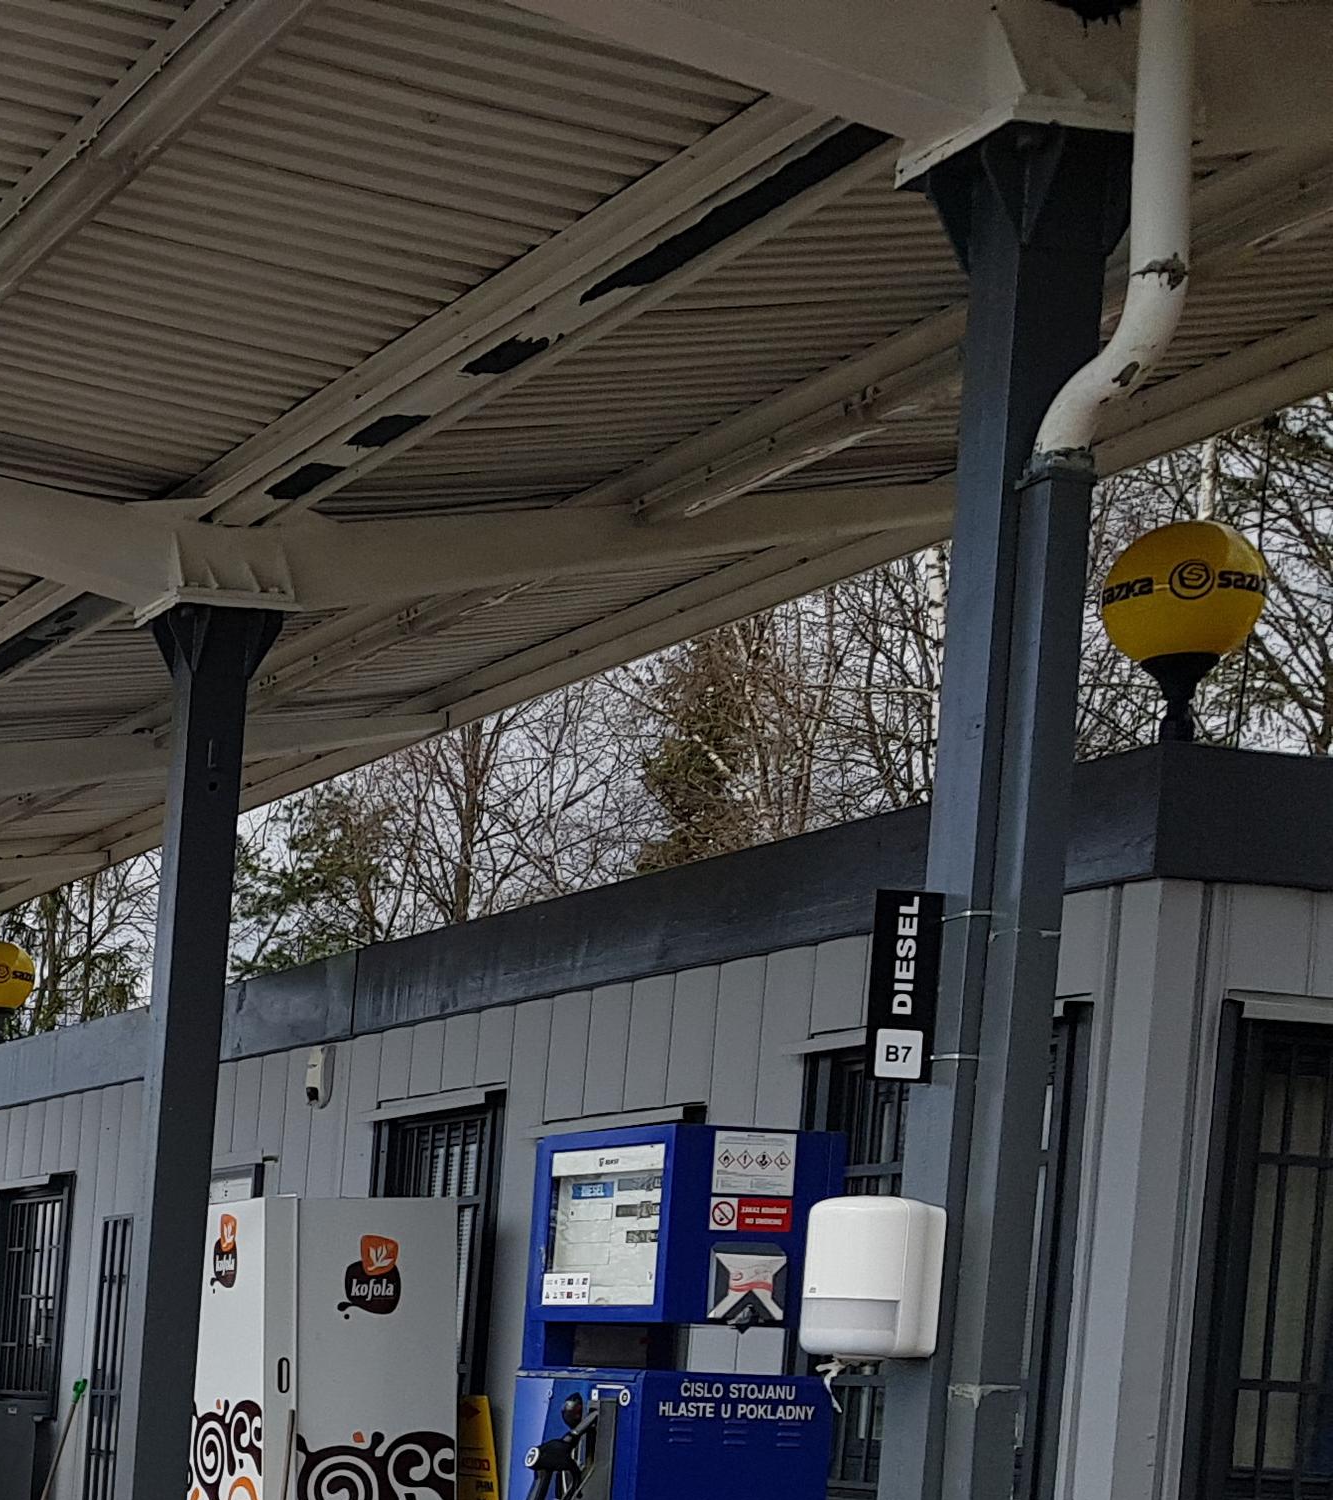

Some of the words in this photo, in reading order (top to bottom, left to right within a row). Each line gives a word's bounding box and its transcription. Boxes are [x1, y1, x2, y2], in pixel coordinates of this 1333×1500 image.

[892, 896, 920, 1015] DIESEL
[885, 1045, 912, 1063] B7
[215, 1254, 235, 1276] kofola
[350, 1278, 395, 1301] kofola
[728, 1383, 796, 1401] STOJANU
[658, 1401, 715, 1418] HLASTE
[721, 1403, 732, 1419] U
[737, 1404, 815, 1421] POKLADNY
